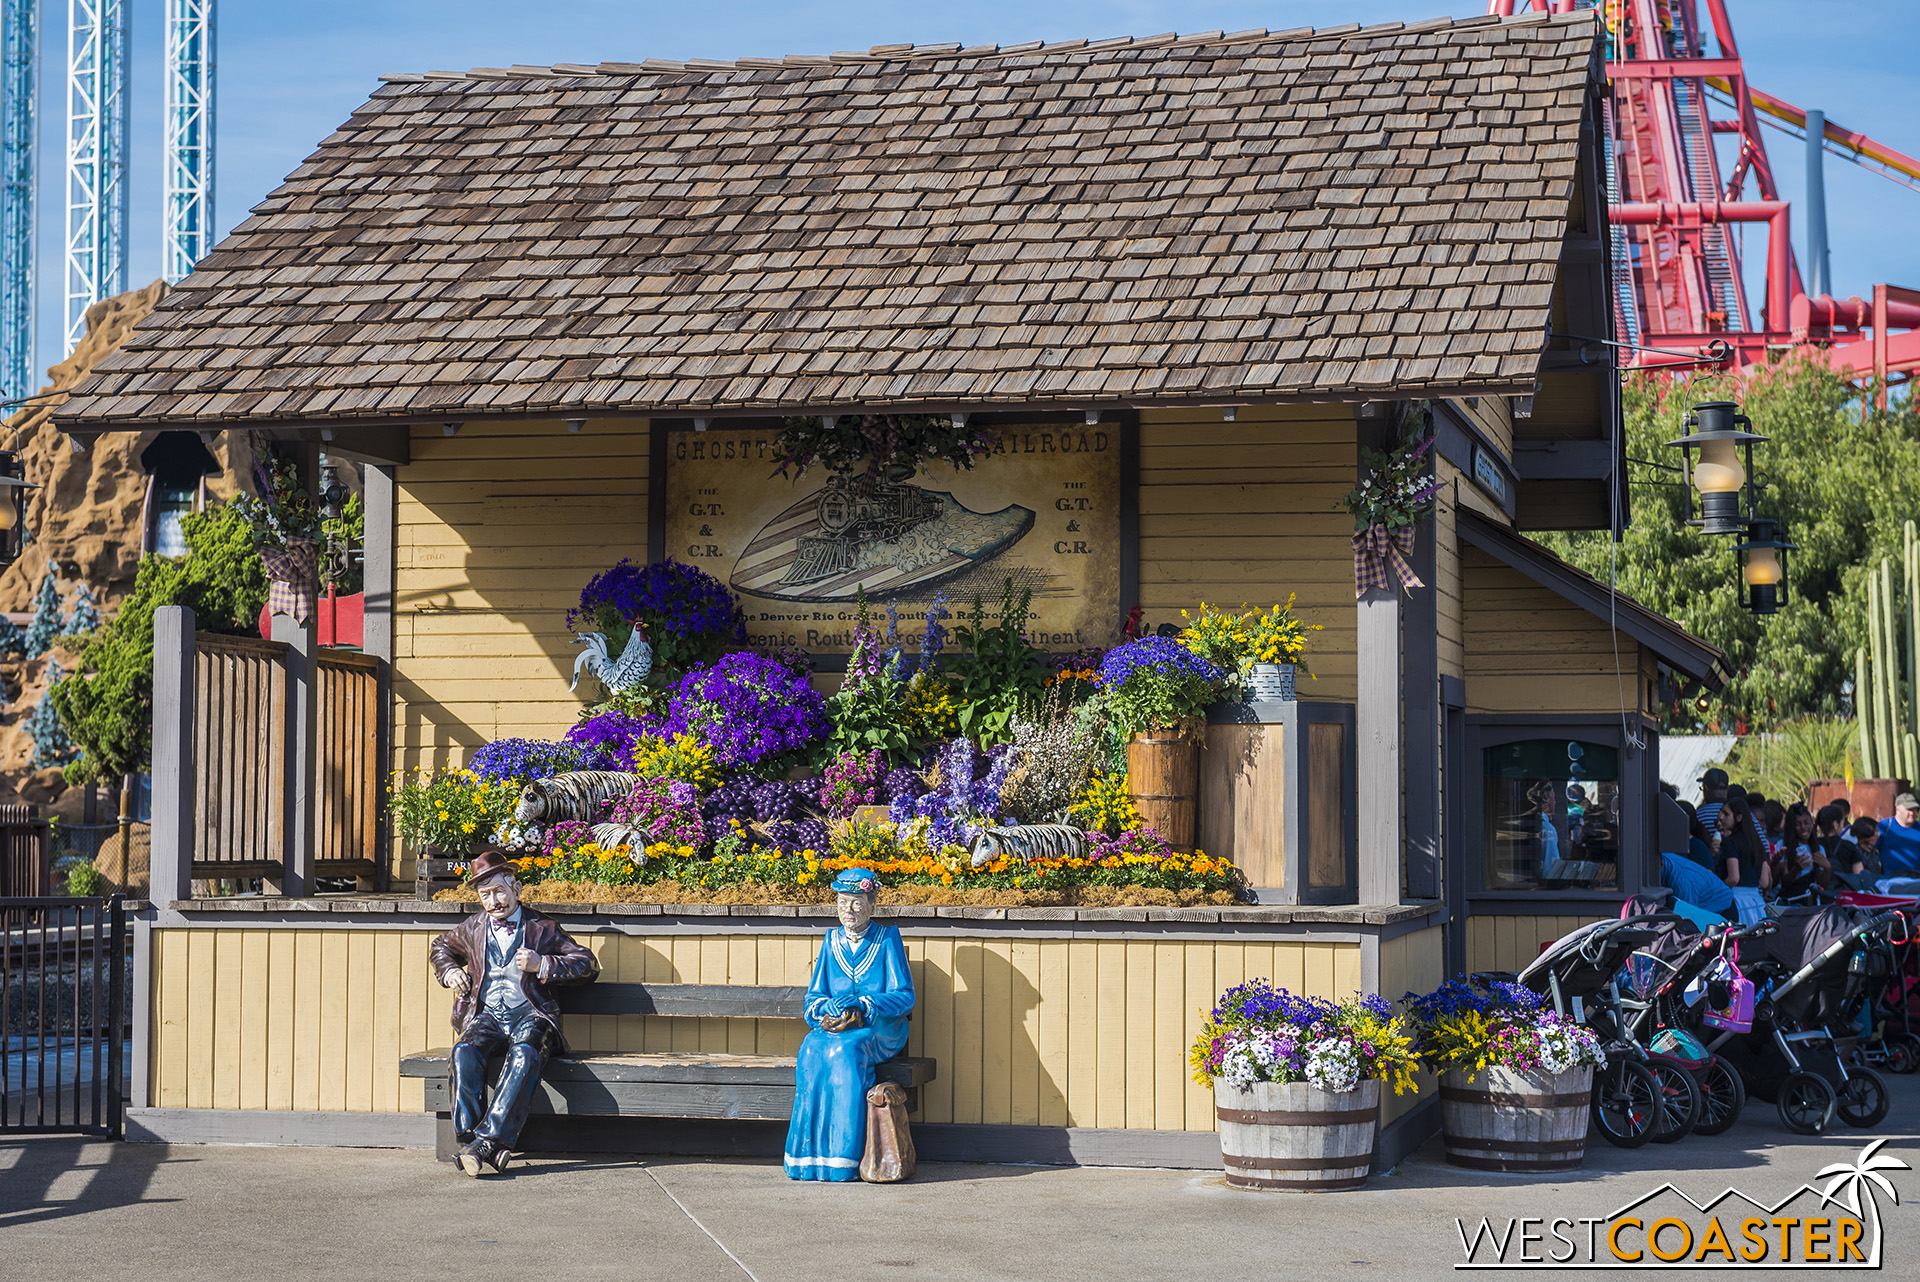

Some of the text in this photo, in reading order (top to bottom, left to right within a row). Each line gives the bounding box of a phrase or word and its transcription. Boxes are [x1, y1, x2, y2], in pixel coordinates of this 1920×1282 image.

[676, 440, 783, 460] GHOSTTO
[984, 432, 1109, 455] AILROAD
[1062, 481, 1087, 489] THE
[689, 503, 725, 516] G.T.
[1055, 497, 1094, 511] G.T.
[699, 523, 713, 537] &
[1065, 519, 1081, 533] &
[687, 544, 723, 557] C.R.
[1053, 540, 1092, 554] C.R.
[759, 612, 809, 622] Denver
[812, 611, 835, 621] Rio
[837, 611, 886, 621] Grade
[890, 611, 953, 620] outhn
[748, 631, 797, 647] cenic
[876, 629, 924, 646] Acros
[1030, 628, 1085, 645] inent
